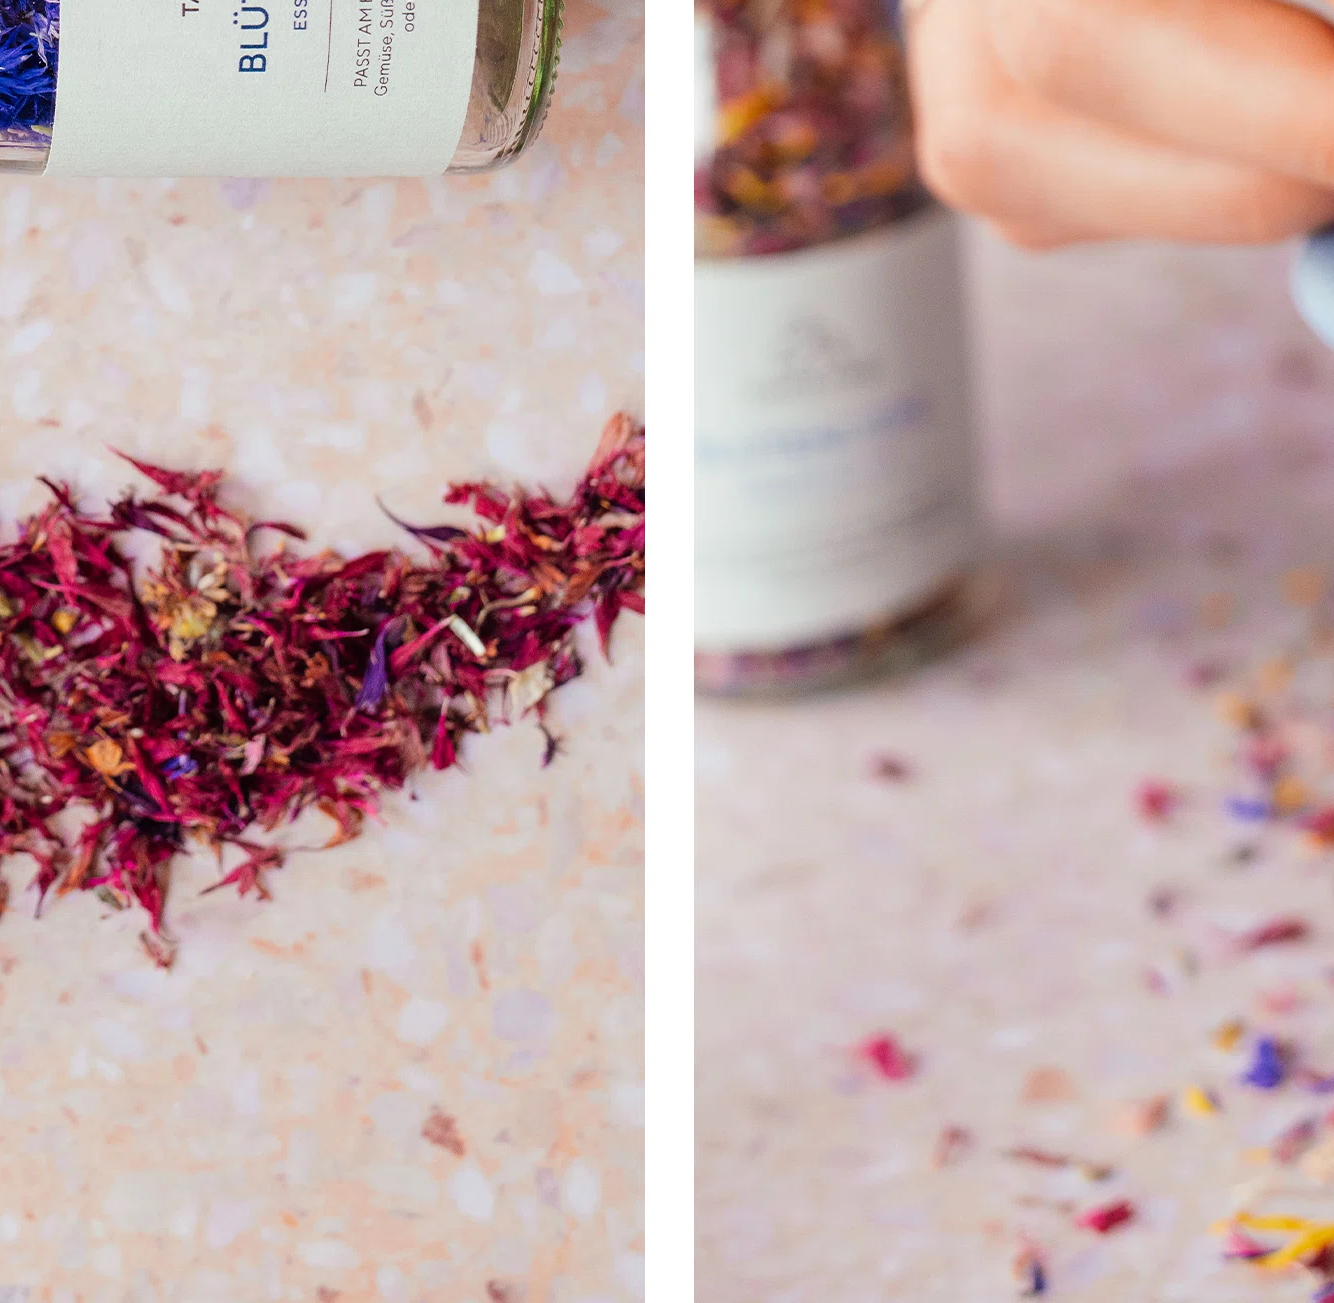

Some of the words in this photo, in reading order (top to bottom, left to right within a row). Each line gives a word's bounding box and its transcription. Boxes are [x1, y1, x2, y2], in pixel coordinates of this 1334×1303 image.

[359, 8, 372, 35] AM
[354, 39, 370, 87] PASST
[374, 33, 394, 96] Gemüse,
